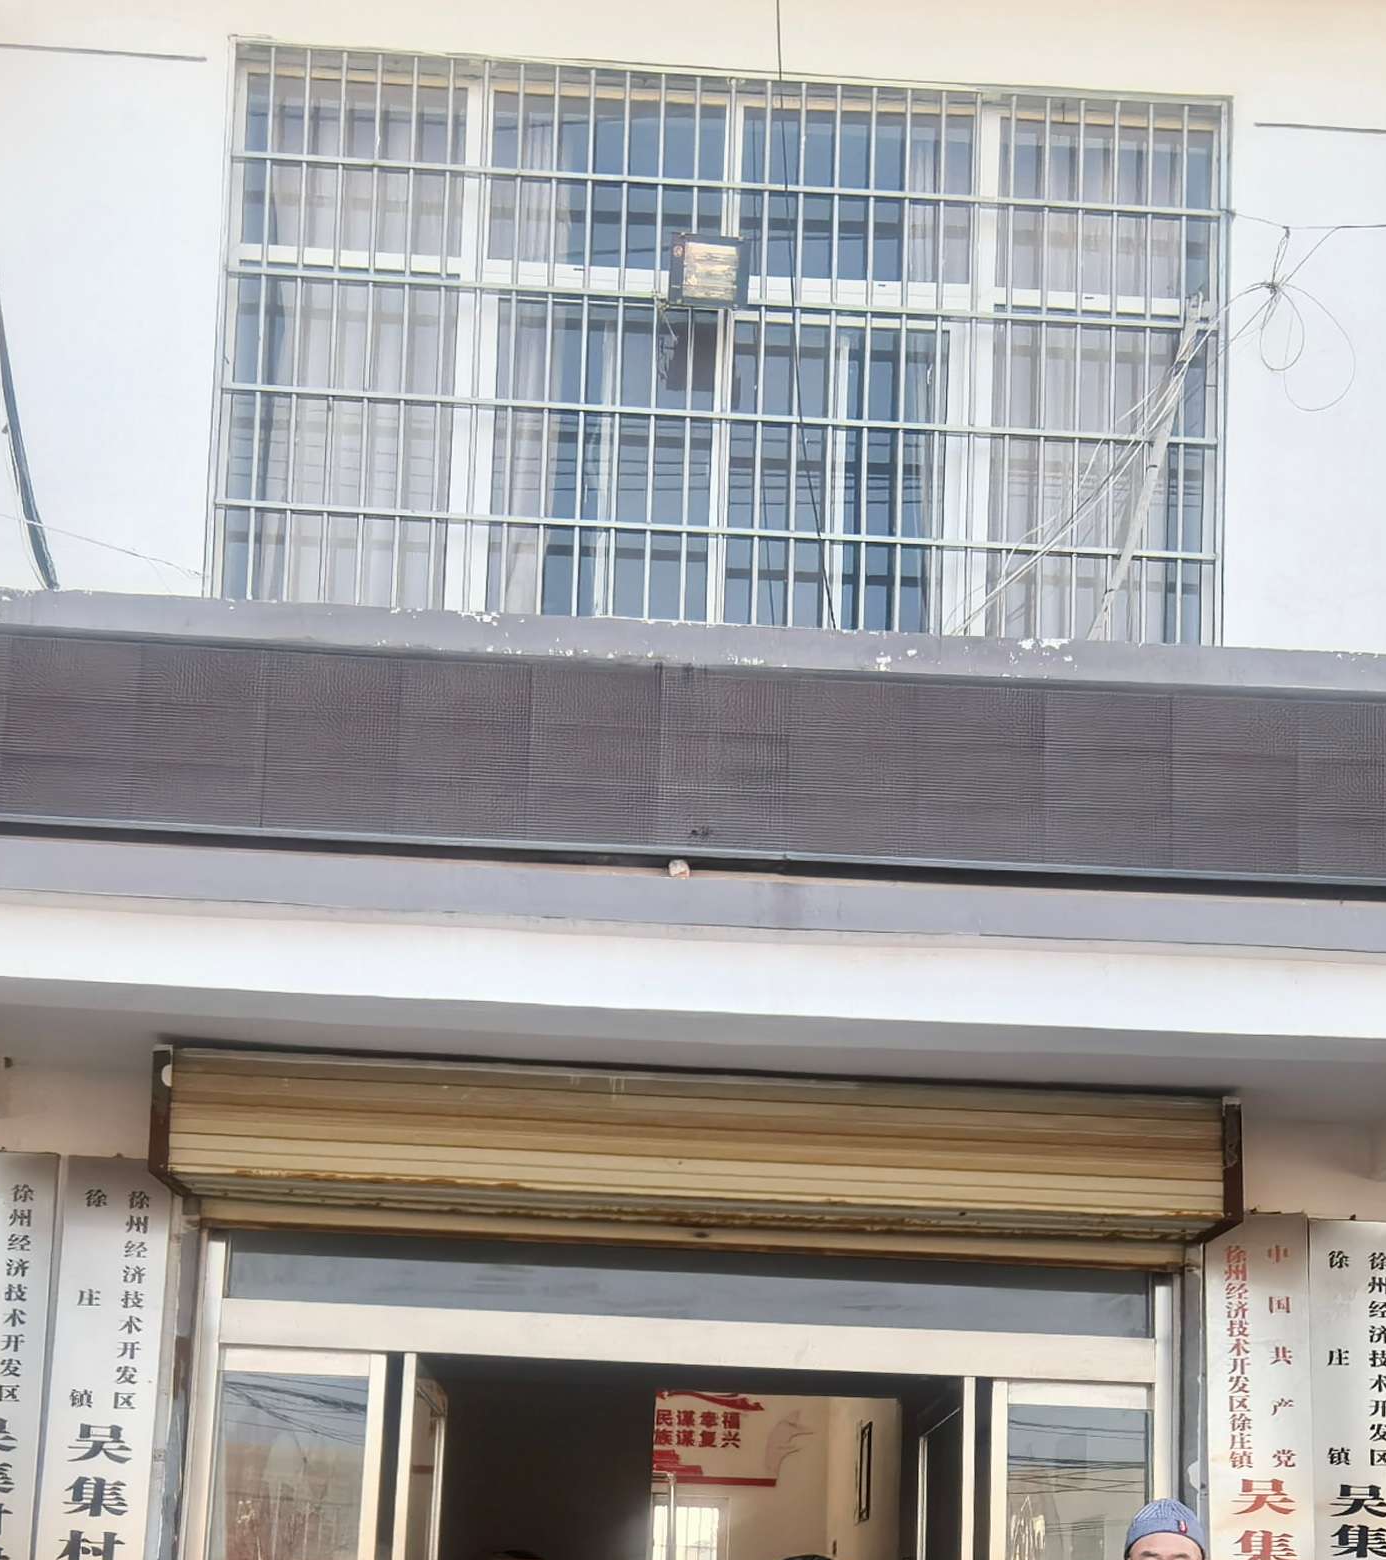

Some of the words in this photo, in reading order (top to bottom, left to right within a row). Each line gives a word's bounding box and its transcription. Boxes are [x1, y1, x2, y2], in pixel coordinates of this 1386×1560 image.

[69, 1188, 107, 1408] 徐庄镇
[113, 1190, 150, 1410] 徐州经济技术开发区
[1224, 1244, 1253, 1469] 徐州经济技术开发区徐庄镇
[1266, 1244, 1297, 1468] 中国共产党
[1327, 1249, 1351, 1467] 徐庄镇
[654, 1429, 741, 1448] 族谋复兴
[656, 1409, 741, 1430] 民谋幸福
